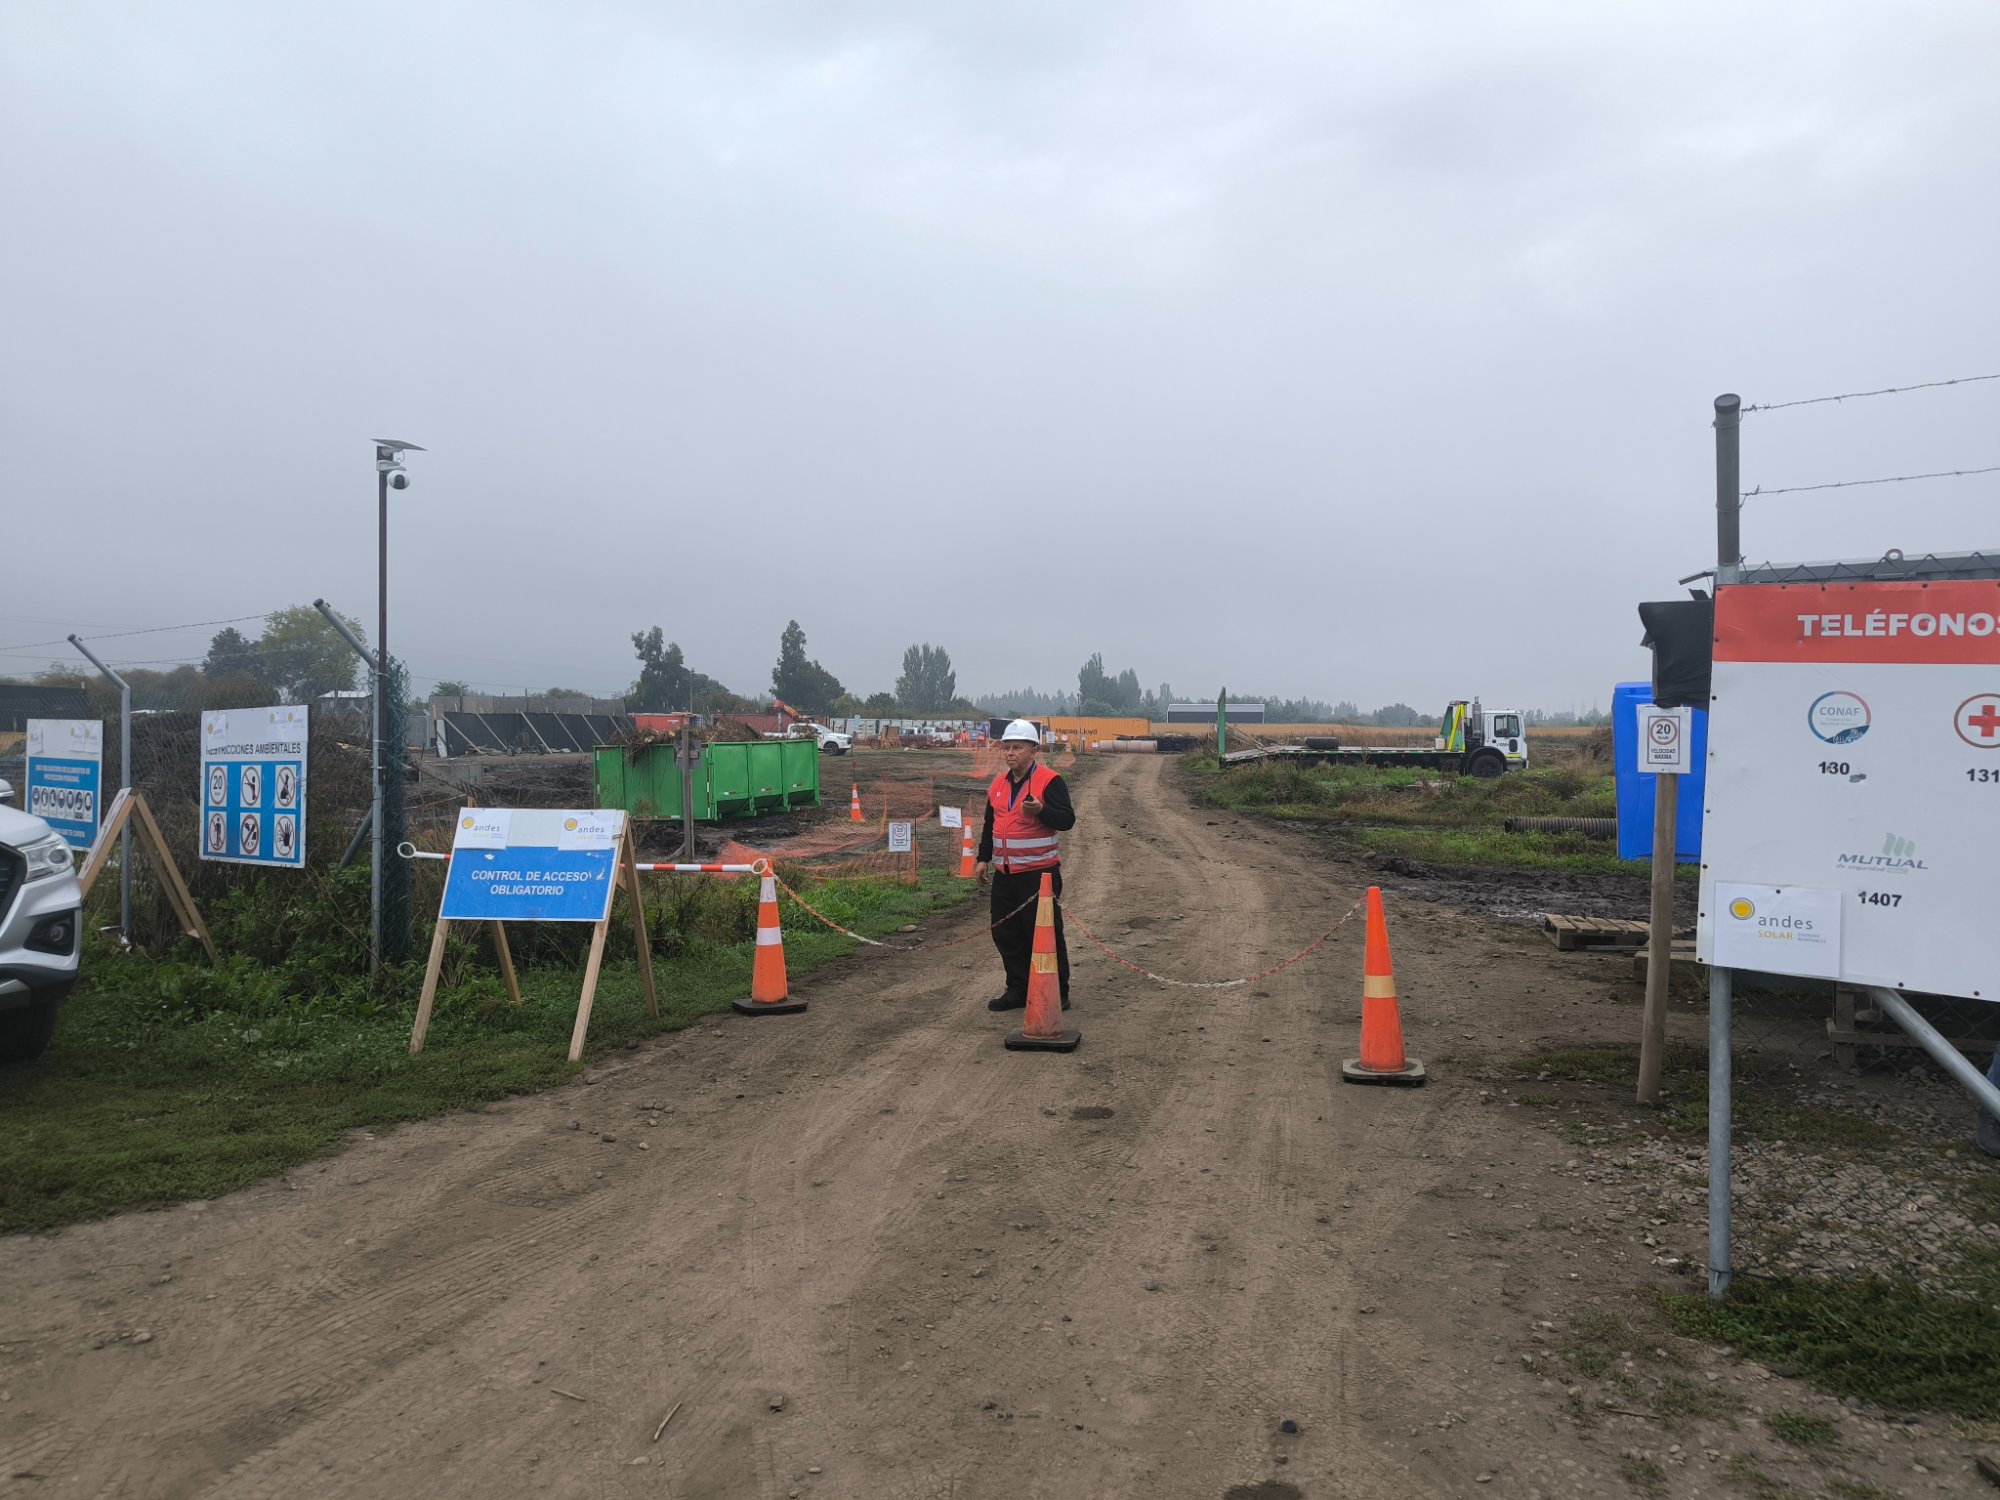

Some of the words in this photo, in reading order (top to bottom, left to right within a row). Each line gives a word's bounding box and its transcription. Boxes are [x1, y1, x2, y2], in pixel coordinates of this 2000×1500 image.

[1797, 608, 2000, 636] TELÉFONO
[1820, 707, 1860, 716] CONAF
[1656, 724, 1671, 734] 20
[255, 743, 301, 754] AMBIENTALES
[1819, 761, 1850, 775] 130
[1967, 768, 1999, 783] 131
[213, 776, 222, 790] 20
[473, 824, 501, 832] andes
[1838, 853, 1929, 870] MUTUAL
[471, 870, 523, 881] CONTROL
[525, 871, 541, 881] DE
[543, 872, 588, 882] ACCESO
[490, 885, 564, 895] OBLIGATORIO
[1858, 891, 1902, 907] 1407
[1758, 915, 1813, 930] andes
[1758, 930, 1793, 940] SOLAR
